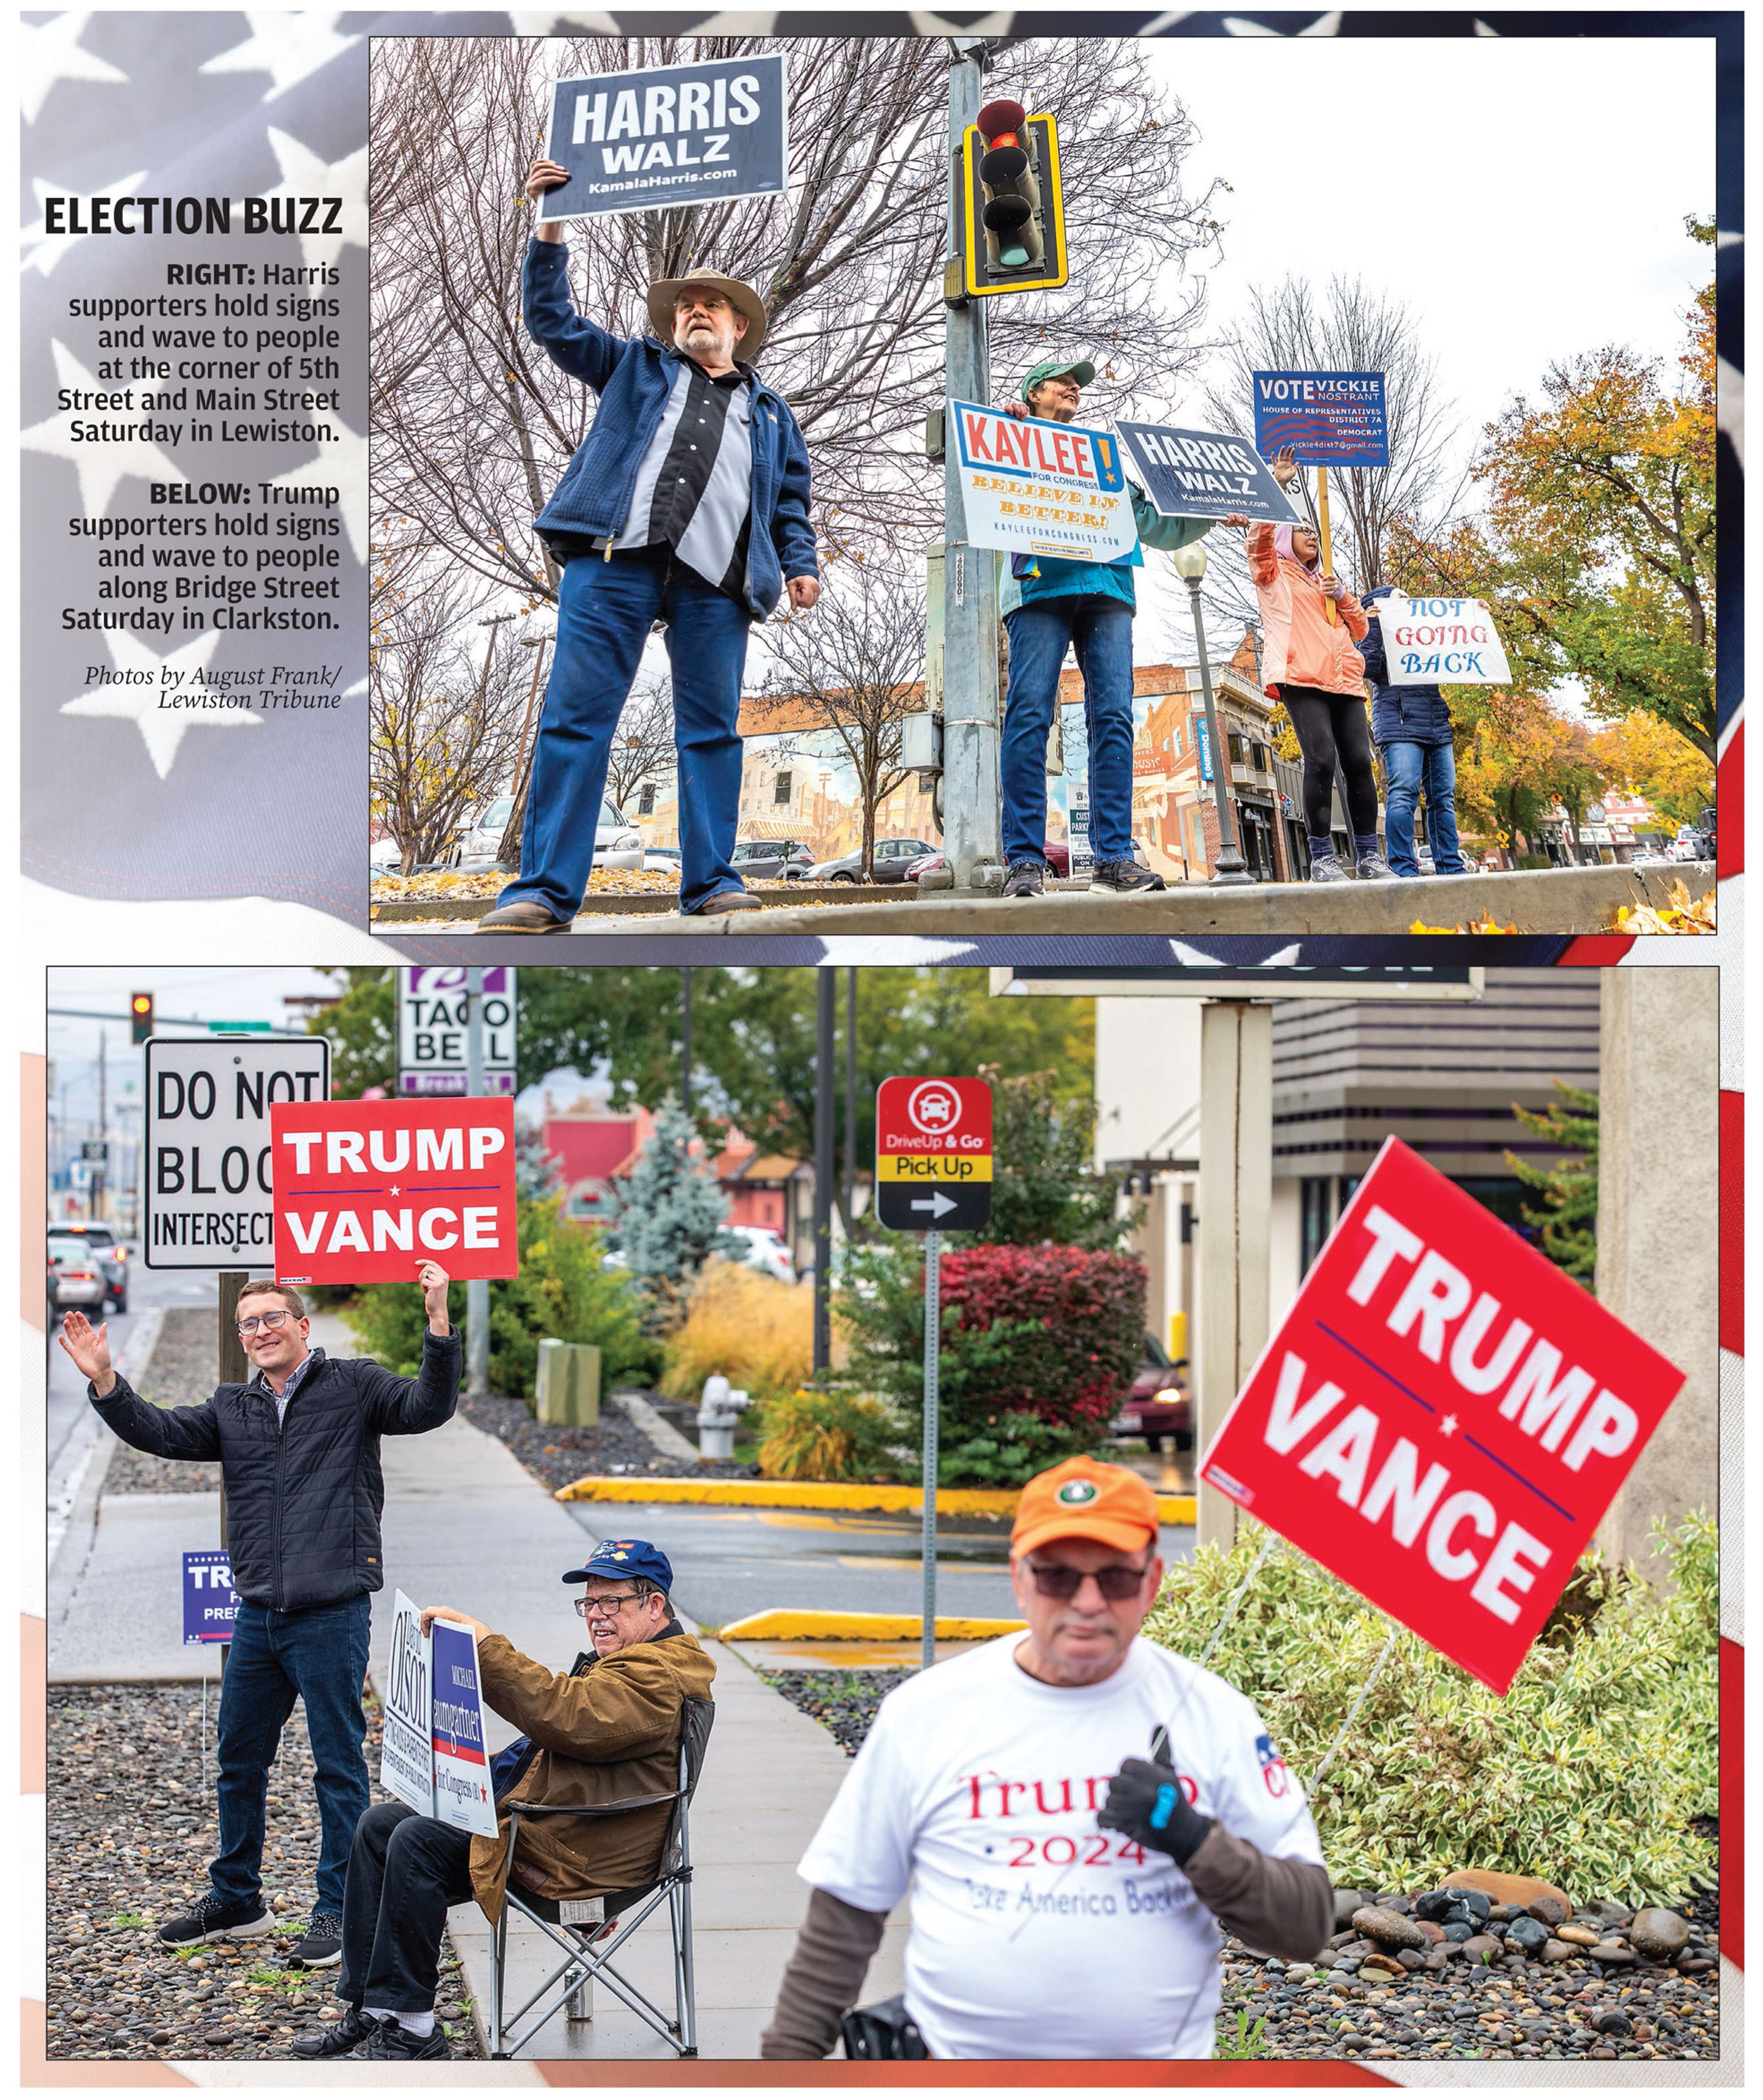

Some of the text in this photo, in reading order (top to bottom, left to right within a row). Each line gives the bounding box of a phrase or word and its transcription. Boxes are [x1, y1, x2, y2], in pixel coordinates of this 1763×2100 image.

[572, 75, 760, 144] HARRIS
[601, 134, 730, 174] WALZ
[589, 168, 737, 195] KamalaHarris.com
[1259, 380, 1380, 400] VOTE VICKIE
[1134, 432, 1258, 476] HARRIS
[972, 475, 1120, 511] BELIEVE IN
[1033, 472, 1099, 491] FOR CONGRESS
[1174, 470, 1258, 496] WALZ
[999, 500, 1109, 530] BETTER!
[1182, 493, 1269, 509] KamalaHarris.com
[994, 522, 1119, 546] KAYLEEFORCONGRESS.COM
[1407, 599, 1466, 617] NOT
[1396, 625, 1488, 646] GOING
[1401, 652, 1486, 677] BACK
[1201, 734, 1213, 778] Domino's
[416, 1034, 508, 1060] BEL
[157, 1070, 320, 1120] DO NOT
[282, 1127, 505, 1175] TRUMP
[886, 1134, 983, 1151] DriveUp & Go
[897, 1156, 973, 1180] Pick Up
[284, 1206, 500, 1254] VANCE
[1345, 1204, 1639, 1473] TRUMP
[1263, 1350, 1553, 1626] VANCE
[391, 1611, 427, 1732] Olson
[451, 1665, 476, 1690] MICHAEL
[432, 1699, 480, 1754] aumgartner
[446, 1768, 472, 1804] Congress
[1009, 1836, 1148, 1866] 2024
[1015, 1883, 1117, 1916] America
